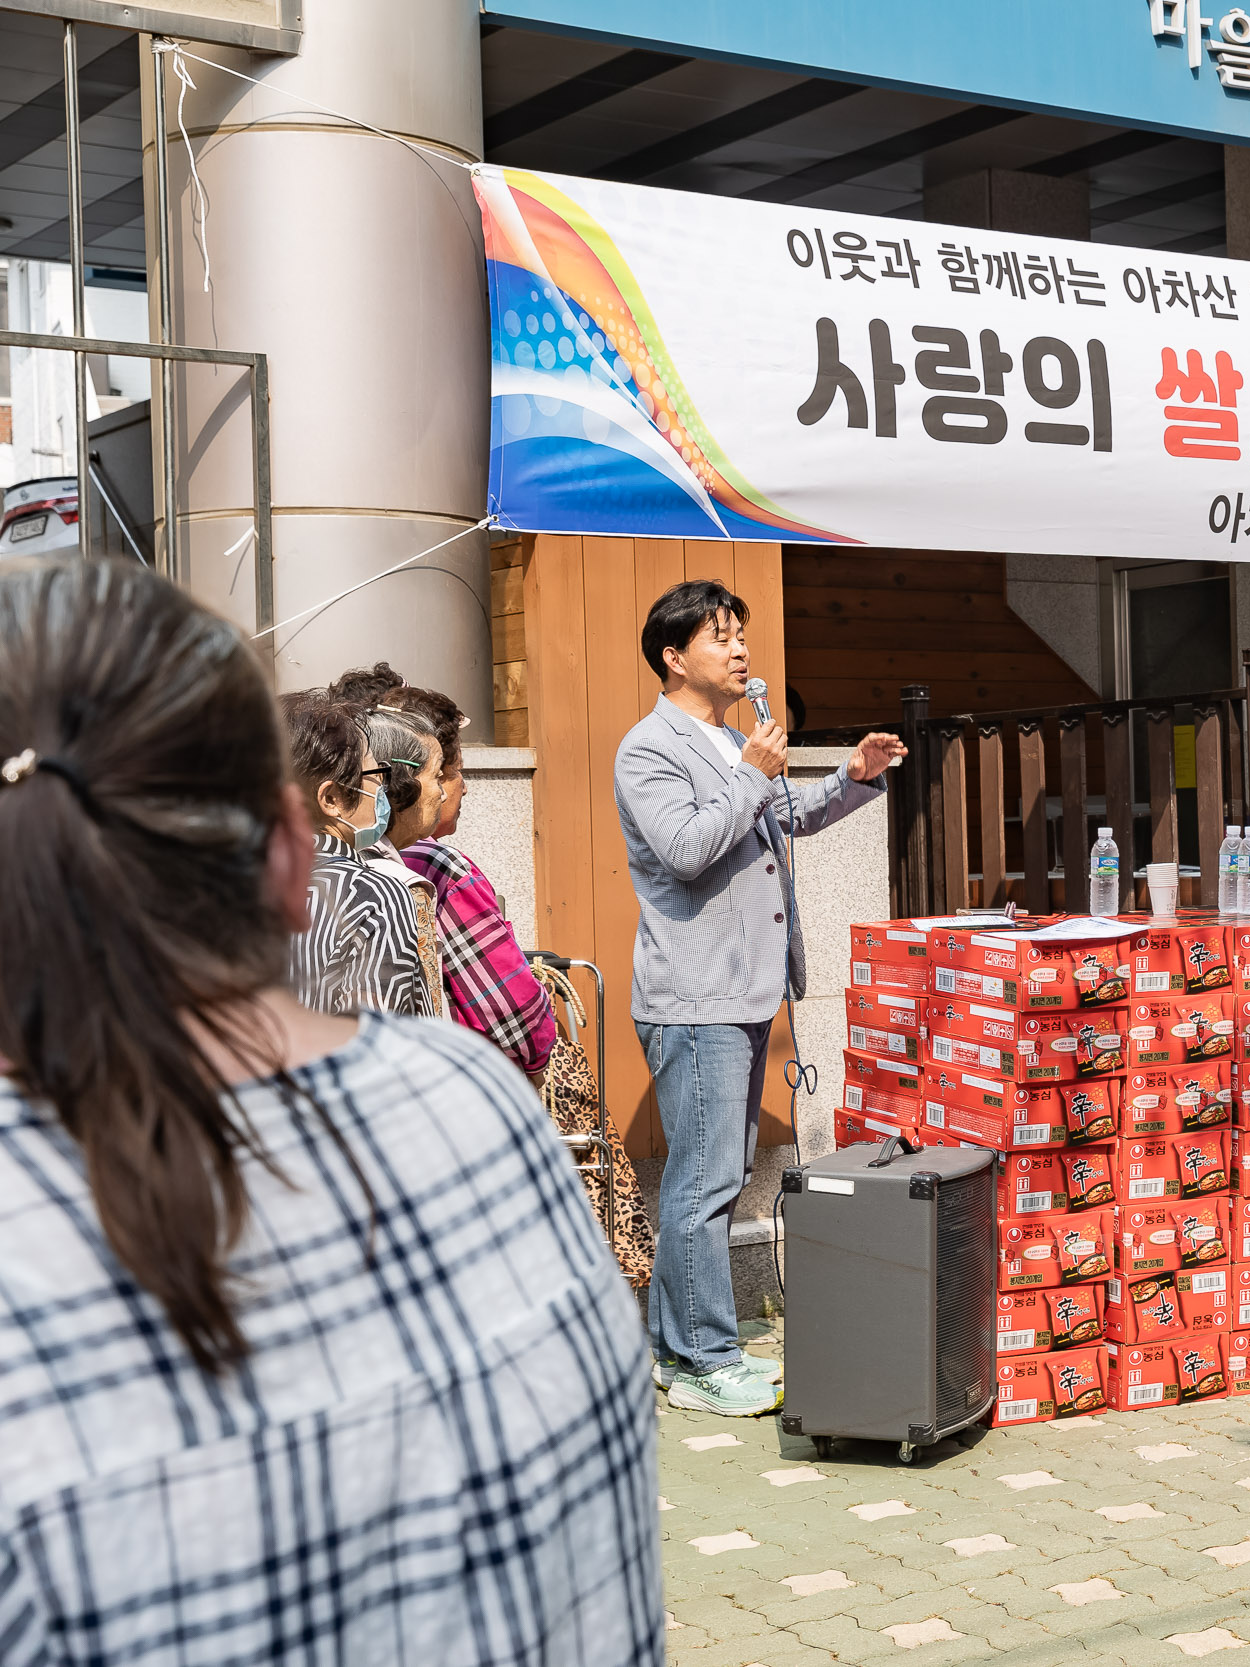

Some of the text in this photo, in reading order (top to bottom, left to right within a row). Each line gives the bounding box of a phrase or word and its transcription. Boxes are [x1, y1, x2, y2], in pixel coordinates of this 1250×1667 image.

[786, 228, 920, 288] 이웃과
[937, 242, 1106, 307] 함께하는
[1123, 266, 1239, 320] 아차산
[797, 317, 1113, 452] 사랑의
[1150, 938, 1170, 949] 농심
[1042, 949, 1063, 960] 농심
[1150, 1006, 1171, 1017] 농심
[1040, 1020, 1061, 1031] 농심
[1029, 1091, 1051, 1101] 농심
[1144, 1146, 1166, 1156] 농심
[1031, 1158, 1053, 1169] 농심
[1145, 1214, 1166, 1225] 농심
[1022, 1228, 1046, 1239] 농심
[1014, 1296, 1036, 1308] 농심
[1143, 1351, 1164, 1361] 농심
[1015, 1366, 1038, 1377] 농심
